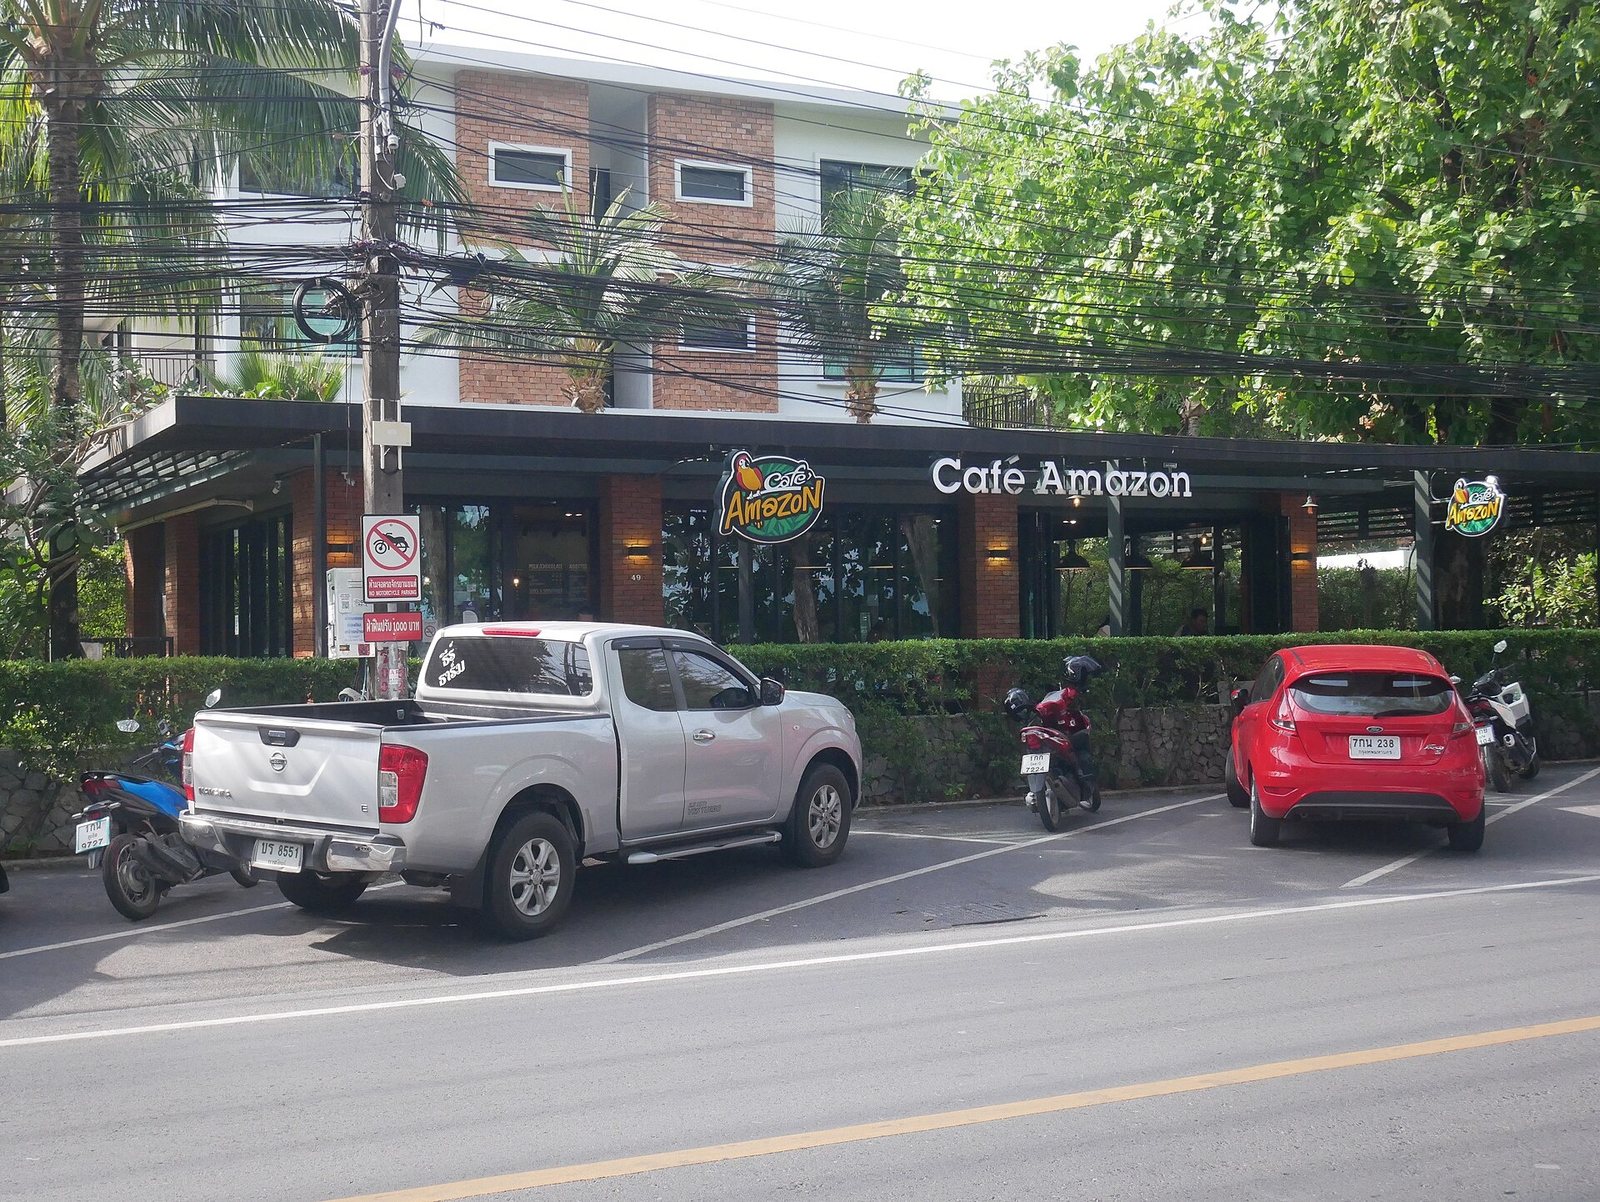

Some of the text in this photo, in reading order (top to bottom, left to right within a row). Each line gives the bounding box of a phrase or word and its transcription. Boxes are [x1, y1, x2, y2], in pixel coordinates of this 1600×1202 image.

[932, 454, 1192, 498] Café Amazon
[408, 621, 420, 631] บาท
[1377, 739, 1395, 748] 238
[277, 844, 299, 859] 8551
